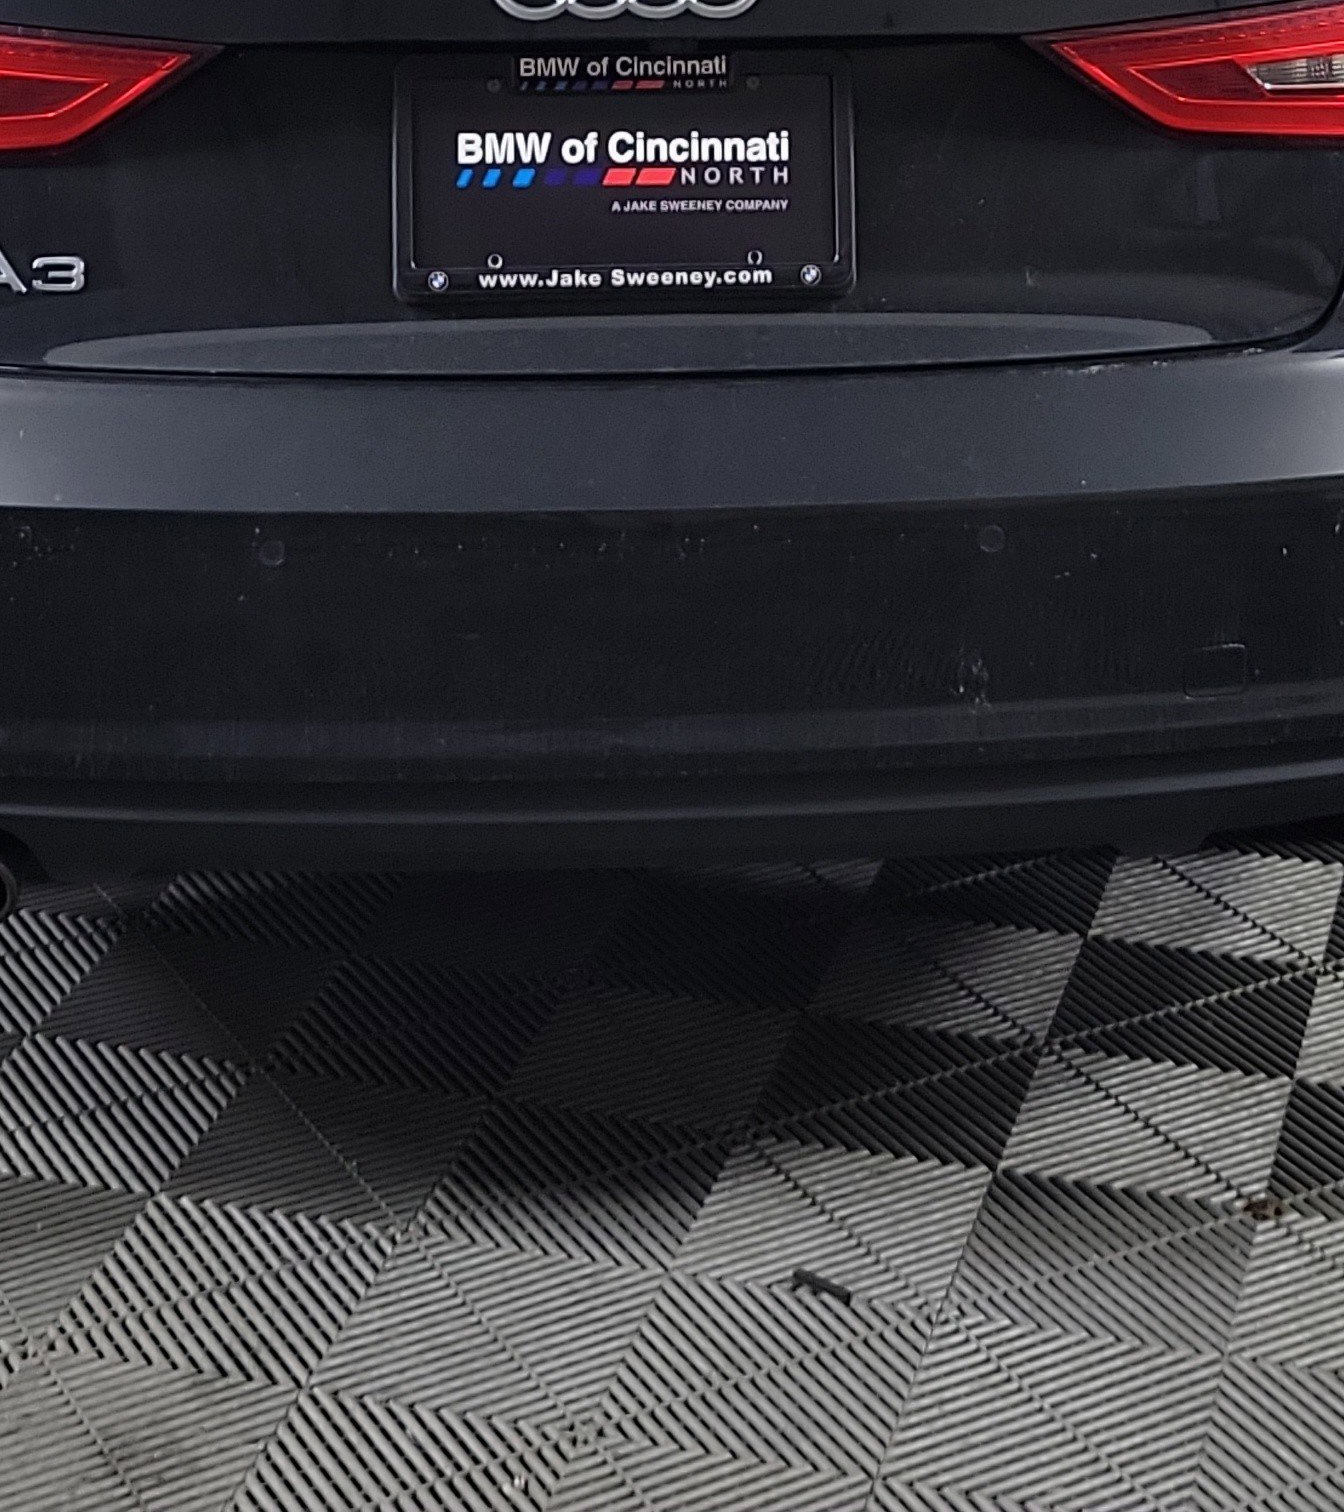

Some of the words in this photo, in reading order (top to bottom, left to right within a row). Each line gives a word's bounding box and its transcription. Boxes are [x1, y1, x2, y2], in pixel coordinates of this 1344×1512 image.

[519, 56, 581, 77] BMW
[586, 55, 610, 76] of
[615, 54, 727, 76] Cincinnati
[673, 79, 728, 89] NORTH
[457, 131, 552, 165] BMW
[560, 130, 600, 165] of
[607, 129, 790, 164] Cincinnati
[680, 165, 789, 186] NORTH
[611, 200, 621, 212] A
[623, 199, 657, 212] JAKE
[659, 199, 723, 212] SWEENEY
[725, 198, 789, 211] COMPANY
[478, 268, 603, 289] www.Jake
[610, 267, 773, 289] Sweeney.com
